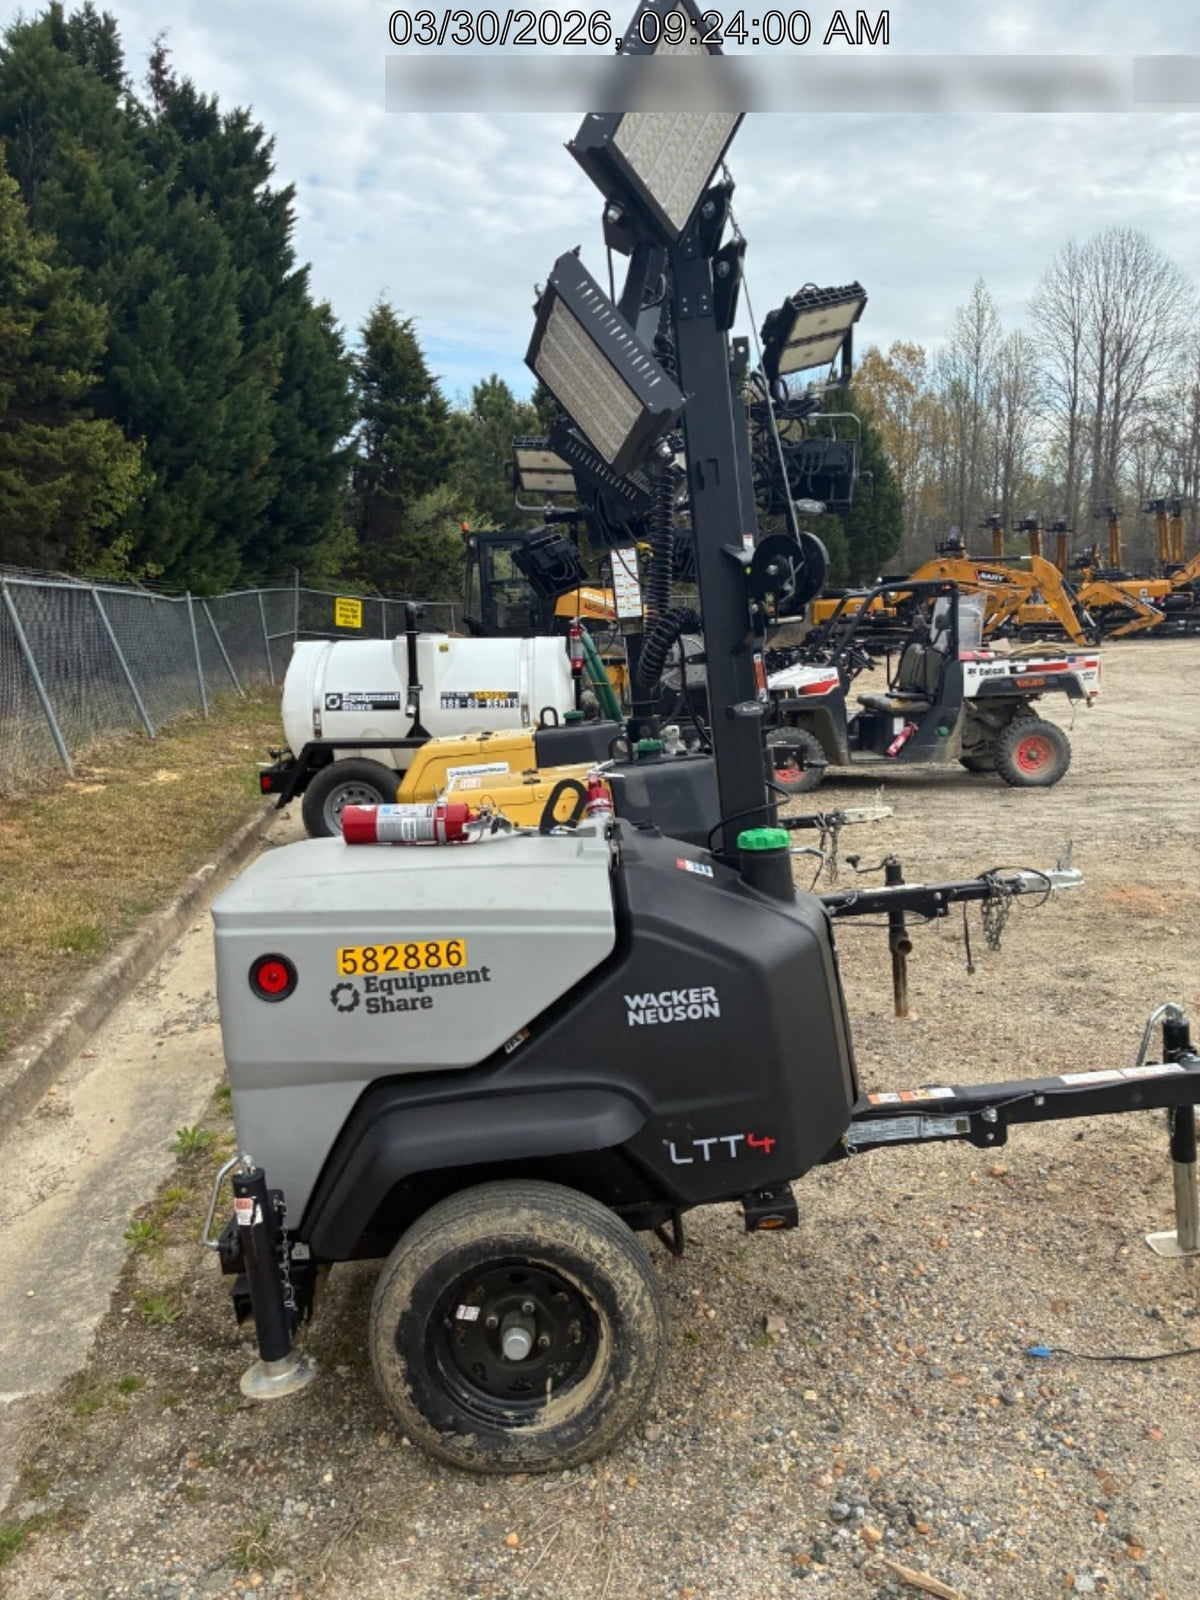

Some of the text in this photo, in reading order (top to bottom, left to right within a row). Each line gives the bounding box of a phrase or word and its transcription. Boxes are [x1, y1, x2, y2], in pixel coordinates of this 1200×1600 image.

[342, 940, 463, 975] 582886
[364, 966, 490, 995] Equipment
[366, 995, 433, 1015] Share
[624, 986, 719, 1010] WACKER
[628, 1003, 721, 1026] NEUSON
[668, 1133, 776, 1165] LTT4
